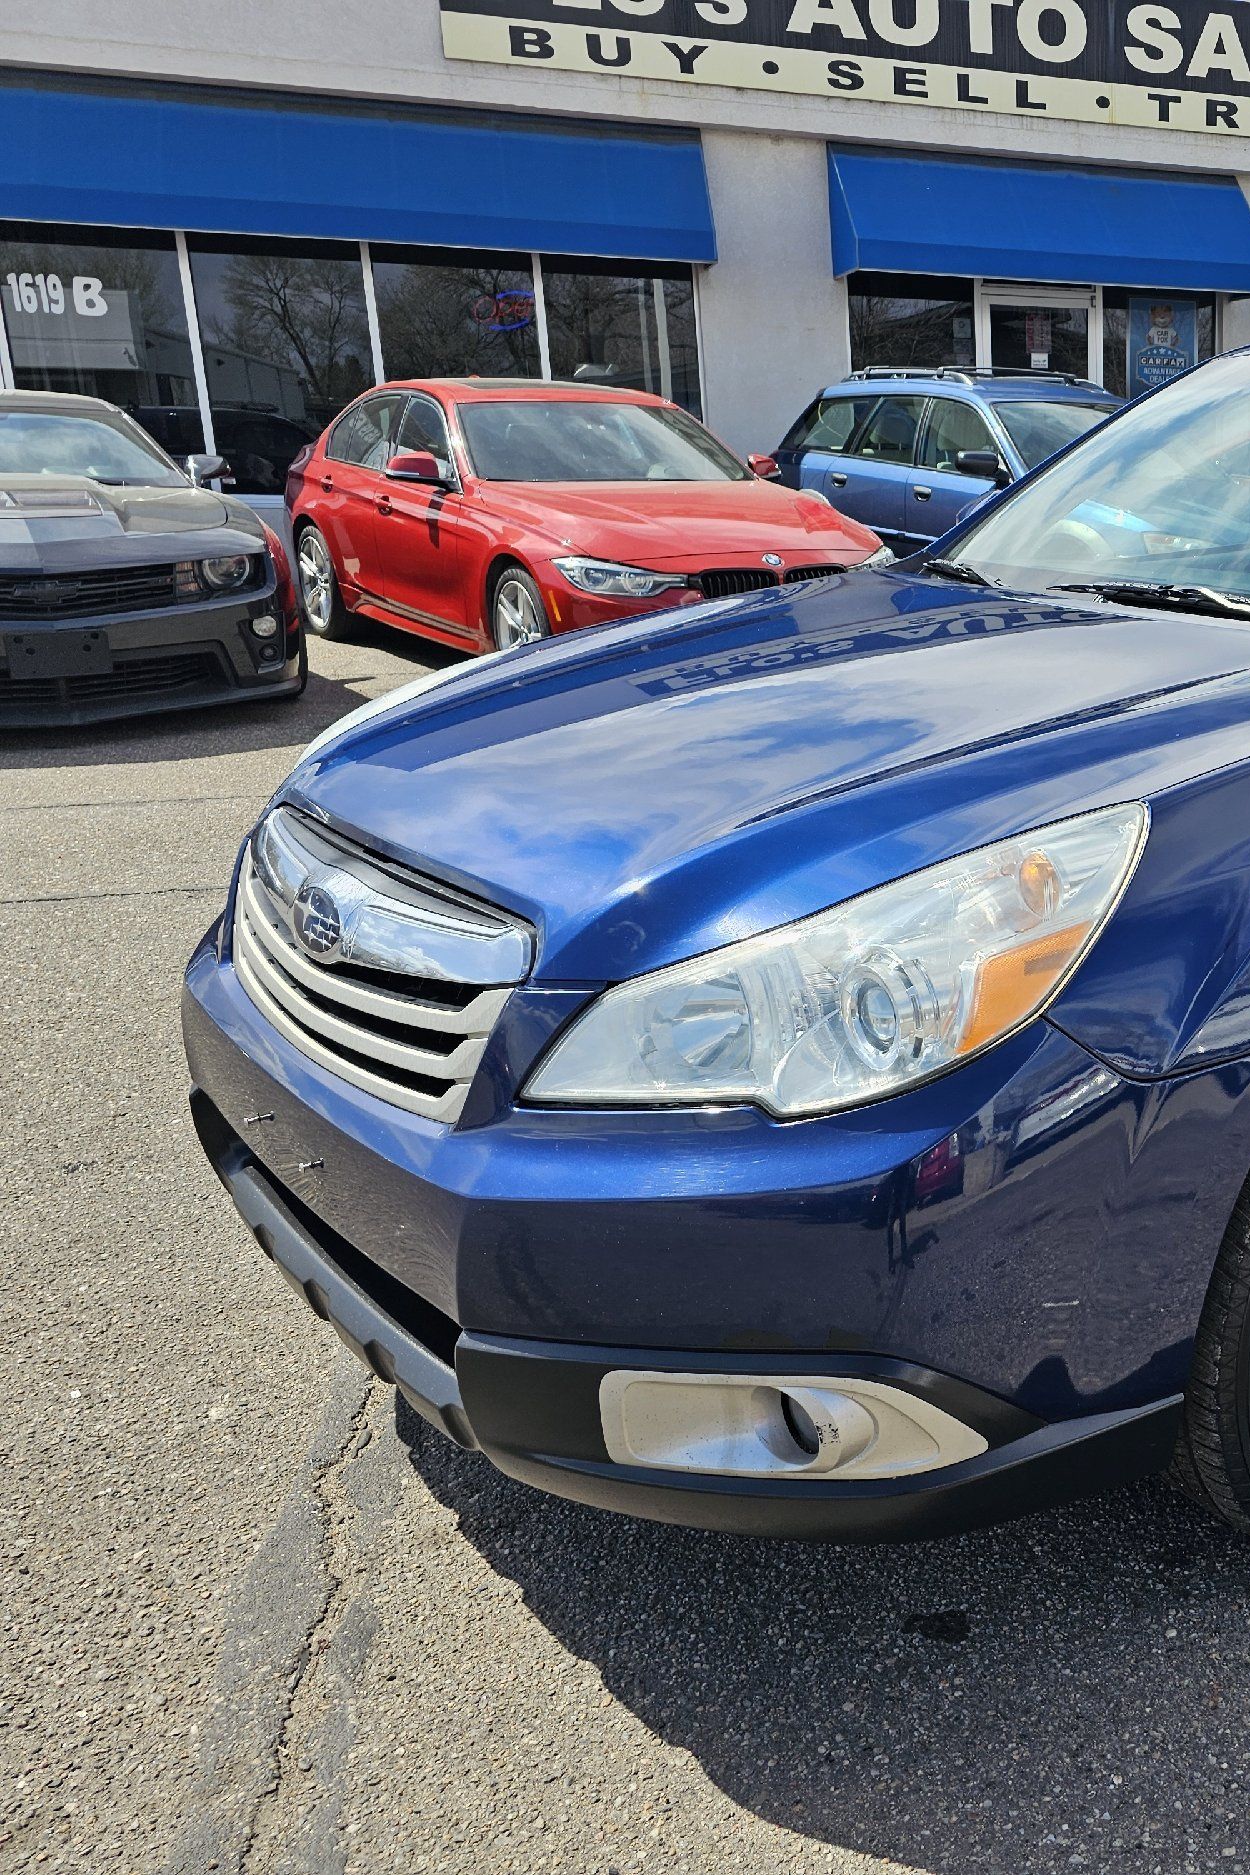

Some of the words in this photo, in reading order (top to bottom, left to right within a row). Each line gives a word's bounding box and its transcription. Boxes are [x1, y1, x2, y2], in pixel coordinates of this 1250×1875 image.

[786, 0, 1087, 63] AUTO
[508, 25, 708, 75] BUY
[826, 60, 1047, 110] SELL
[6, 272, 65, 315] 1619
[72, 275, 108, 317] B
[1140, 356, 1185, 368] CARFAX
